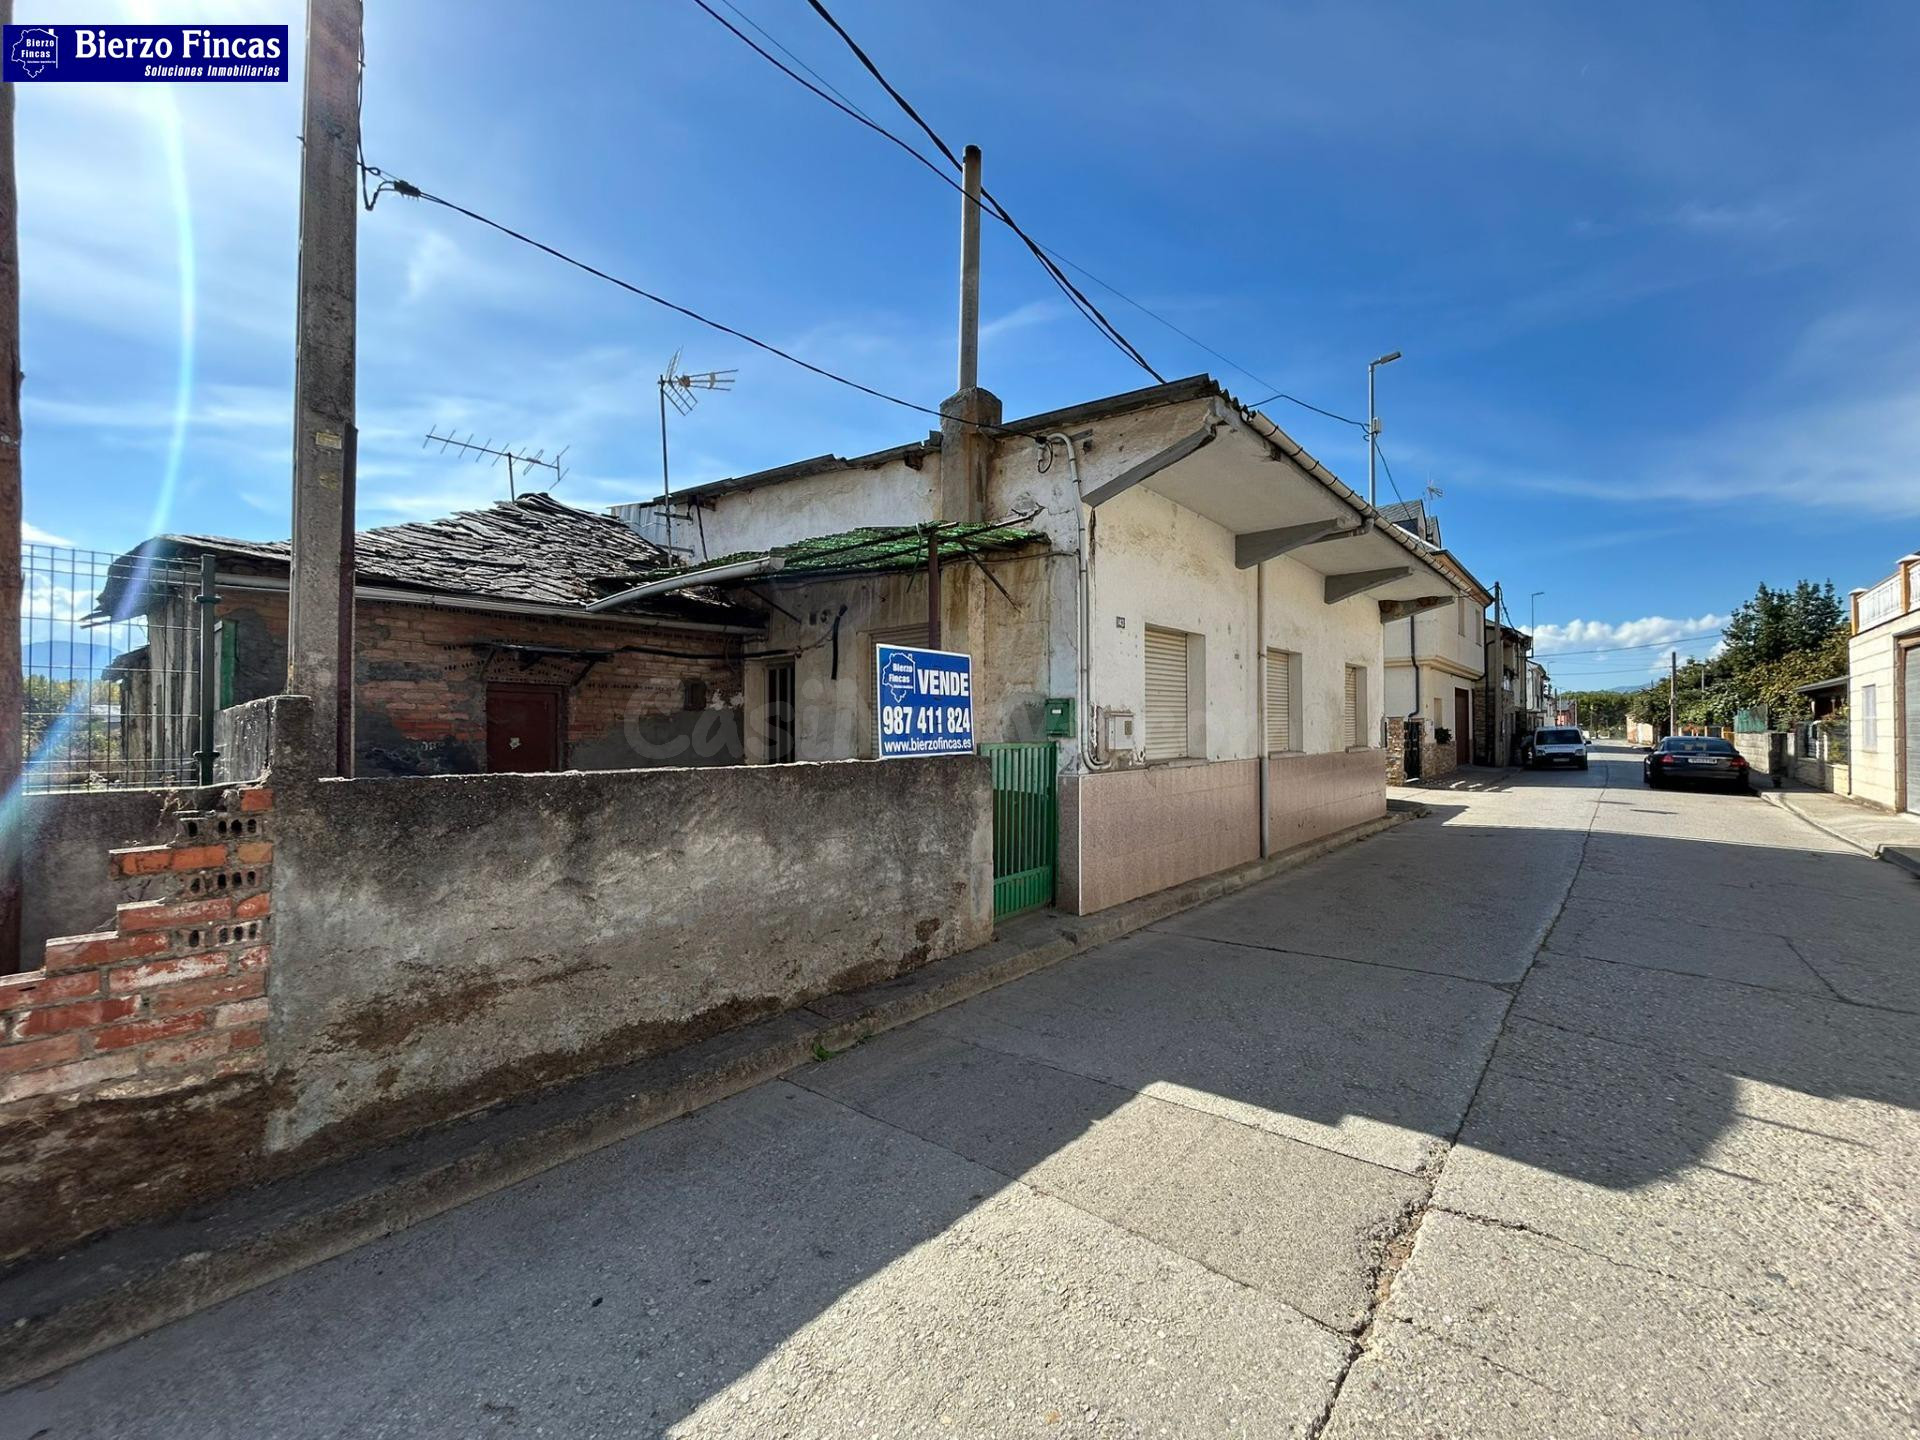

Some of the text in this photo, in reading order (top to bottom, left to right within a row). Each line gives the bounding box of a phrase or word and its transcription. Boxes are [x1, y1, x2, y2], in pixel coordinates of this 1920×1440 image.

[892, 663, 913, 673] Bierzo
[888, 673, 910, 683] Fincas
[917, 669, 969, 696] VENDE
[883, 706, 970, 735] 987 411 824
[884, 738, 972, 752] www.bierzofincas.es
